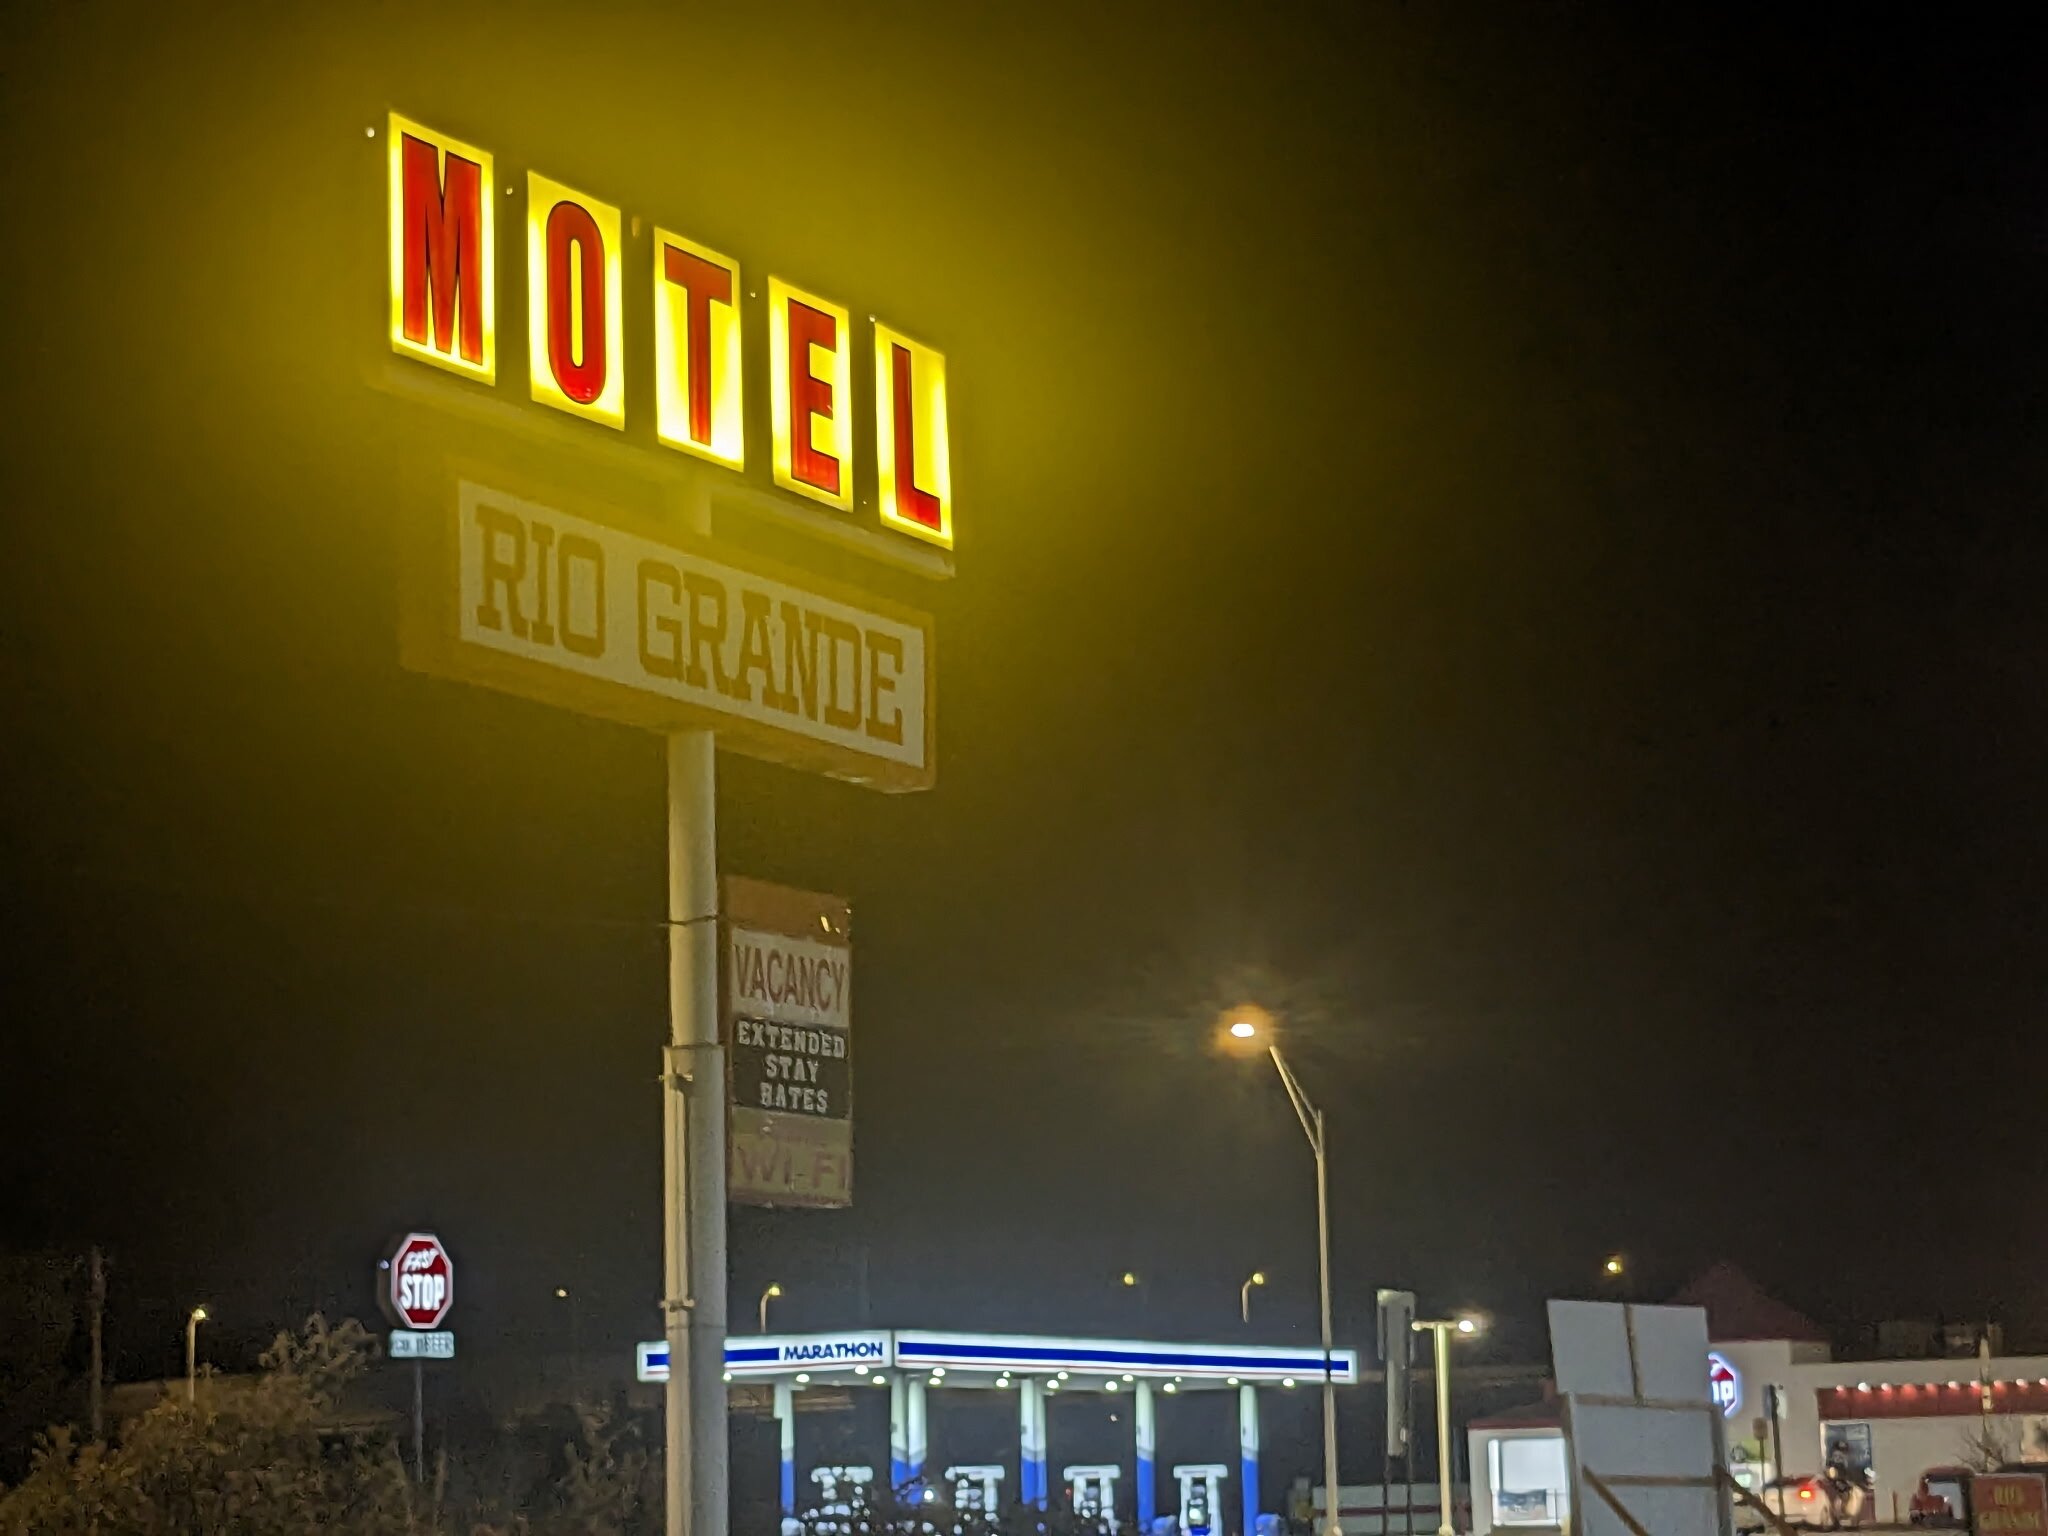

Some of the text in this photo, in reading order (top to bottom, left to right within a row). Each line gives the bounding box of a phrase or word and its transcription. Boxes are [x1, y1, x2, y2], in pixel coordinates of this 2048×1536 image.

[401, 130, 942, 533] MOTEL
[475, 503, 905, 746] RIO GRANDE
[734, 943, 845, 1013] VACANCY
[738, 1020, 845, 1059] EXTENDED
[764, 1054, 819, 1084] STAY
[401, 1273, 445, 1310] STOP
[784, 1342, 883, 1360] MARATHON
